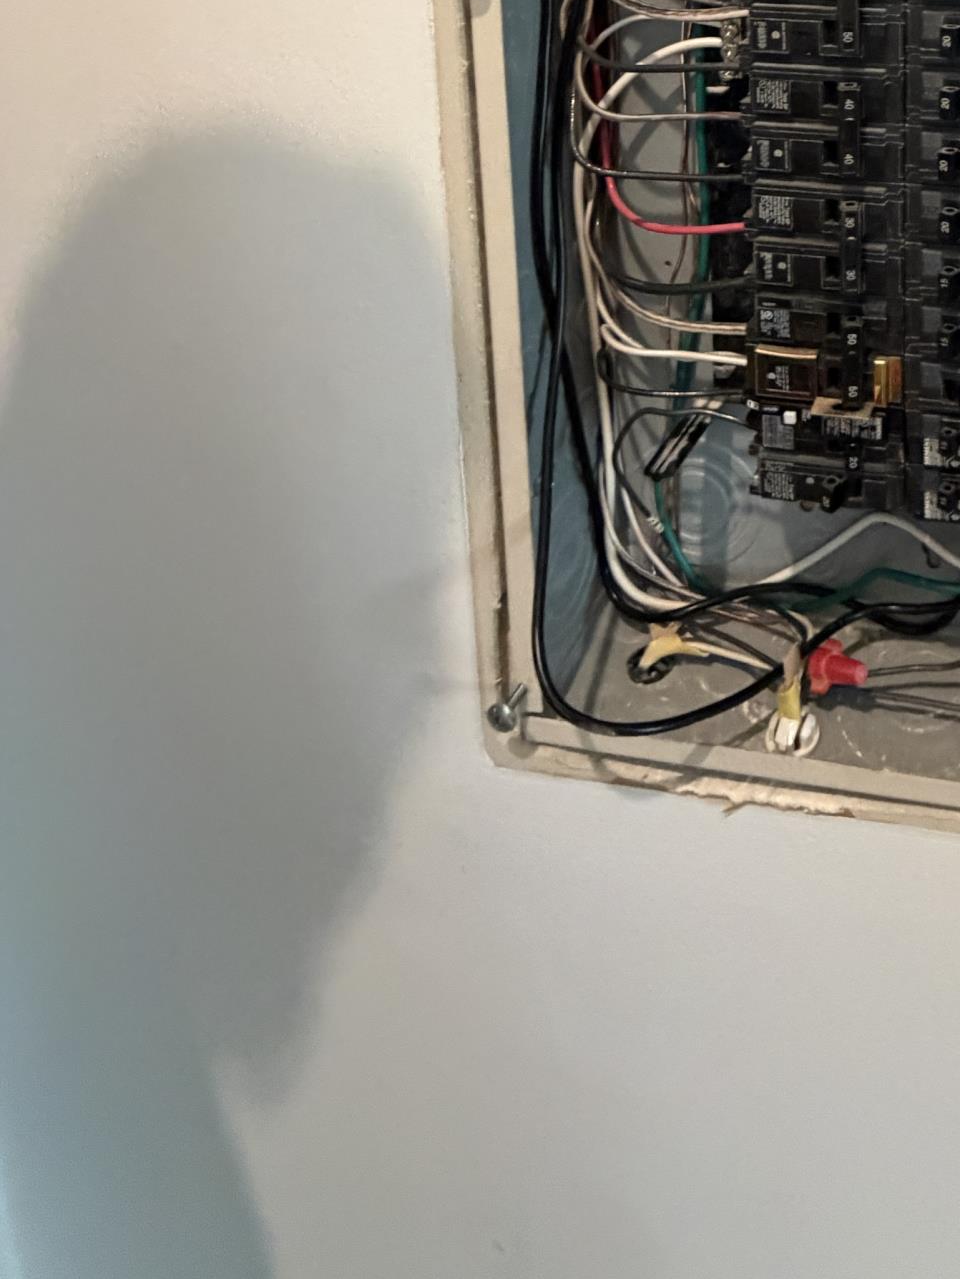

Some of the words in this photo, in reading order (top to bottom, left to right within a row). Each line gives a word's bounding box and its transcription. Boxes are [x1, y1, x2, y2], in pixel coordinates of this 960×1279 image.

[942, 36, 951, 48] 20
[844, 99, 855, 110] 40
[940, 98, 950, 110] 20
[844, 154, 855, 165] 40
[938, 160, 948, 172] 20
[845, 218, 855, 228] 30
[940, 221, 950, 233] 20
[846, 270, 856, 281] 30
[939, 278, 949, 288] 15
[849, 456, 859, 469] 20
